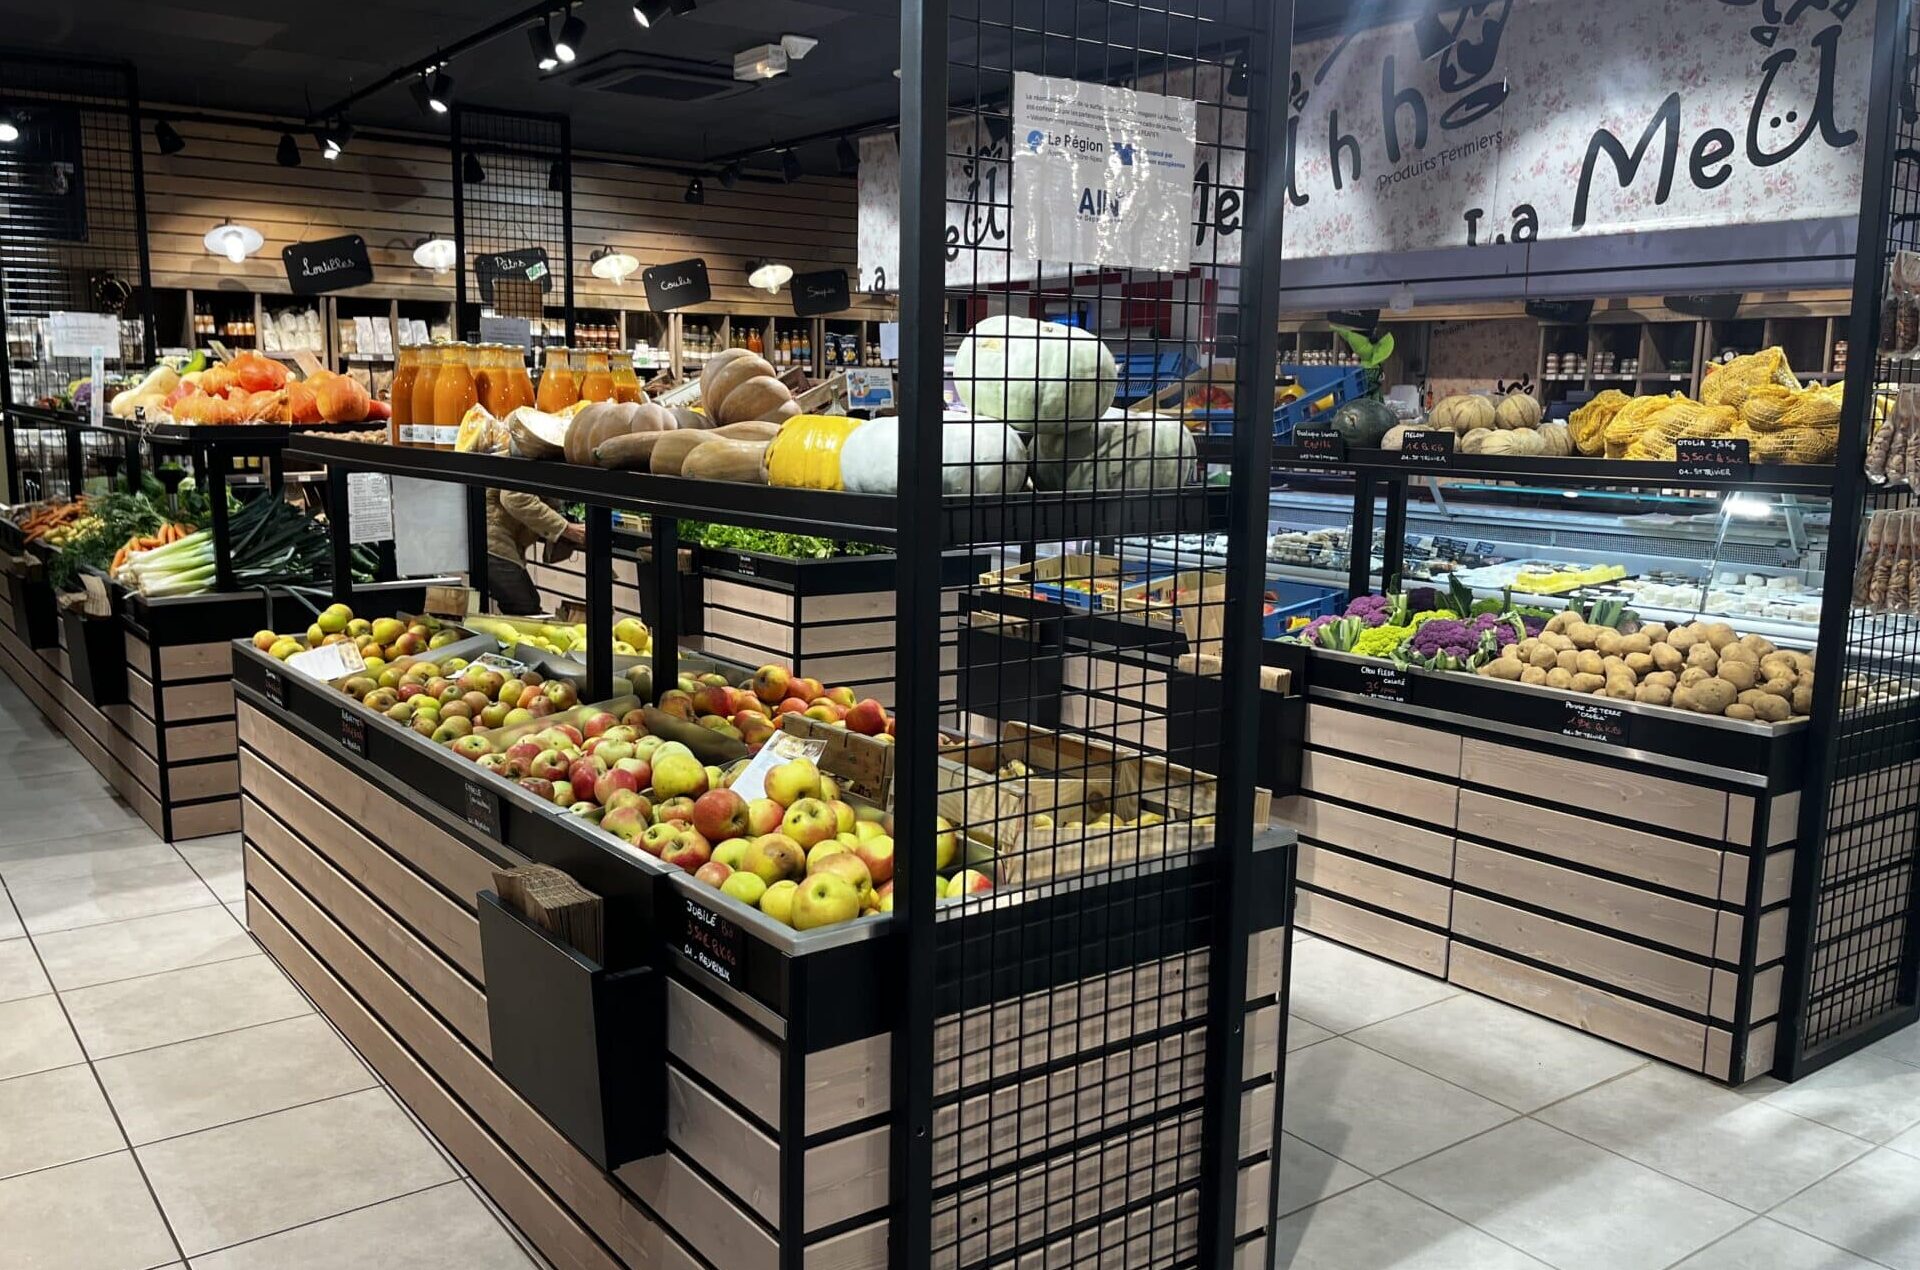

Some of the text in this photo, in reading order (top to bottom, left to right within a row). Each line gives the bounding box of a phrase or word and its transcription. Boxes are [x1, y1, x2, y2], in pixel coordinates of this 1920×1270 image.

[1048, 131, 1103, 153] La Région
[1377, 130, 1503, 190] Produits Fermiers
[686, 900, 718, 927] JUBILÉ
